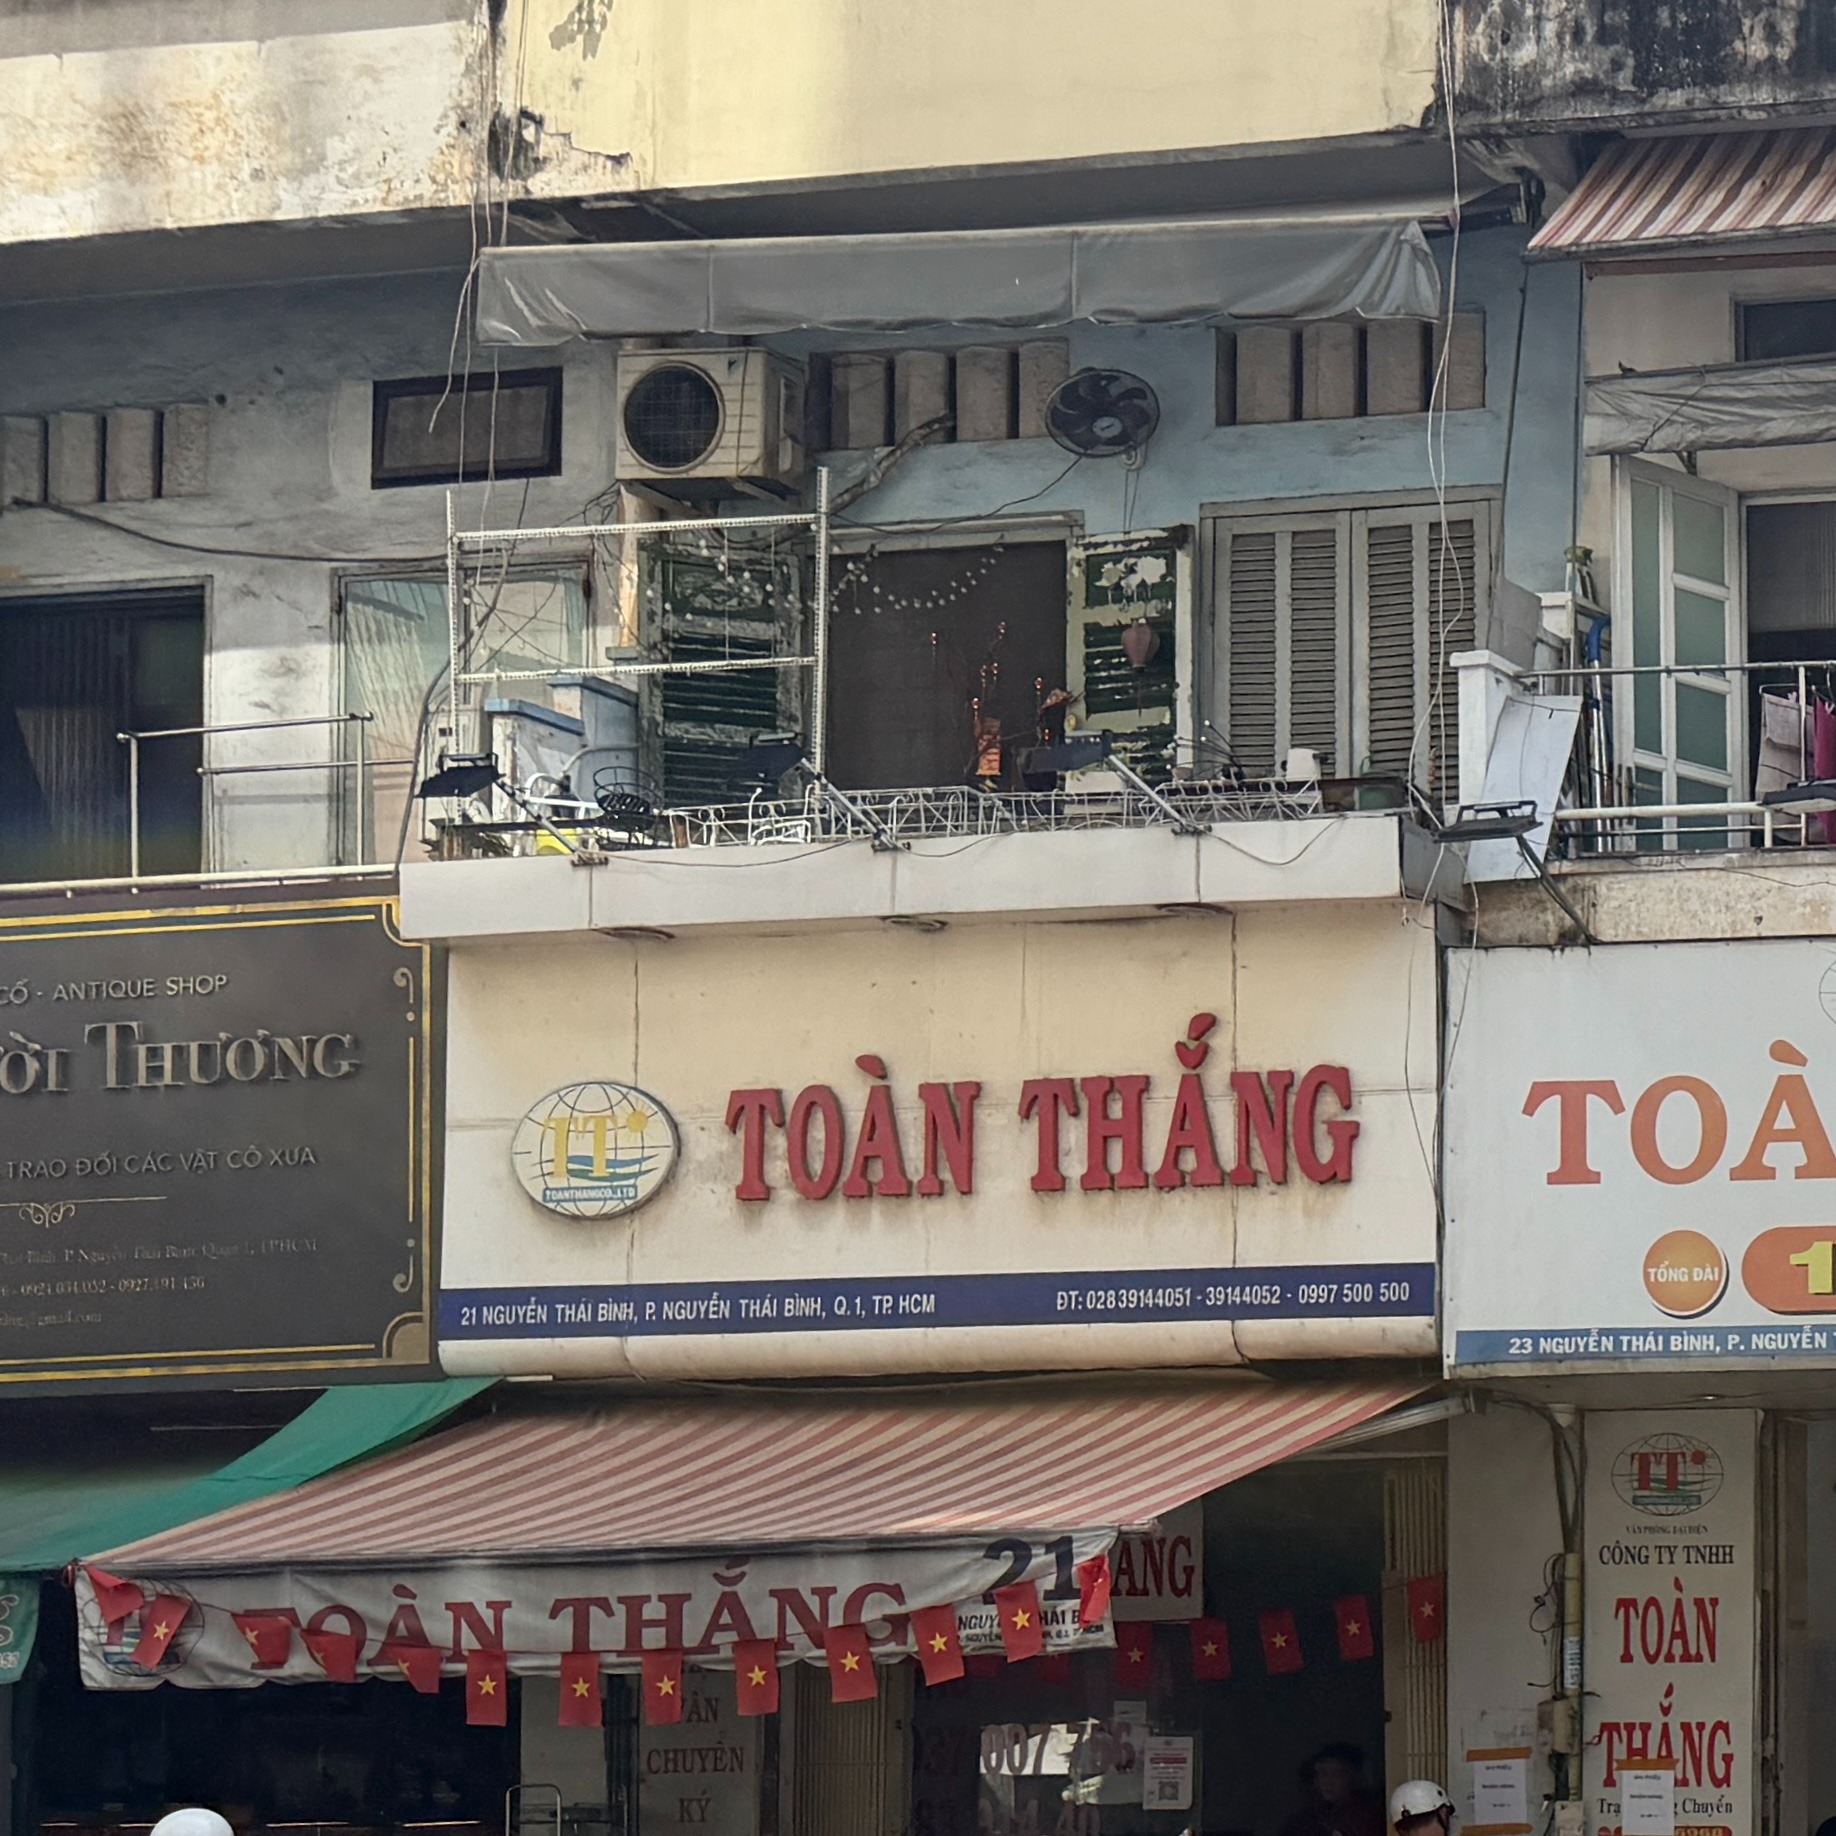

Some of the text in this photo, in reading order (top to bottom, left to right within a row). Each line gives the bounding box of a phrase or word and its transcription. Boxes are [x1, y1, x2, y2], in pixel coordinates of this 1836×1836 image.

[54, 974, 228, 1001] ANTIQUE SHOP
[725, 1011, 1360, 1201] TOÀN THẮNG
[7, 1158, 67, 1180] TRAO
[124, 1149, 172, 1175] CÁC
[1692, 1260, 1719, 1282] ĐÀI
[460, 1306, 477, 1327] 21
[482, 1296, 548, 1325] NGUYỄN
[555, 1297, 593, 1324] THÁI
[597, 1297, 638, 1325] BÌNH,
[645, 1301, 657, 1320] P.
[662, 1291, 731, 1321] NGUYỄN
[738, 1293, 778, 1319] THÁI
[784, 1293, 827, 1320] BÌNH,
[872, 1295, 893, 1315] TP.
[898, 1293, 937, 1315] HCM
[1056, 1290, 1083, 1311] ĐT:
[1205, 1284, 1282, 1307] 39144052
[1298, 1283, 1338, 1304] 0997
[1343, 1281, 1374, 1303] 500
[1379, 1280, 1411, 1302] 500
[1508, 1337, 1533, 1355] 23
[1539, 1328, 1614, 1354] NGUYỄN
[1619, 1330, 1663, 1352] THÁI
[1670, 1330, 1722, 1354] BÌNH,
[1727, 1334, 1745, 1351] P.
[1751, 1325, 1828, 1350] NGUYỄN
[1599, 1540, 1735, 1566] CÔNG TY TNHH
[982, 1534, 1082, 1605] 21
[548, 1555, 909, 1659] THẮNG
[957, 1609, 1002, 1630] NGUY
[1614, 1575, 1720, 1665] TOÀN
[1600, 1681, 1735, 1789] THẮNG
[1599, 1797, 1622, 1818] Trạ
